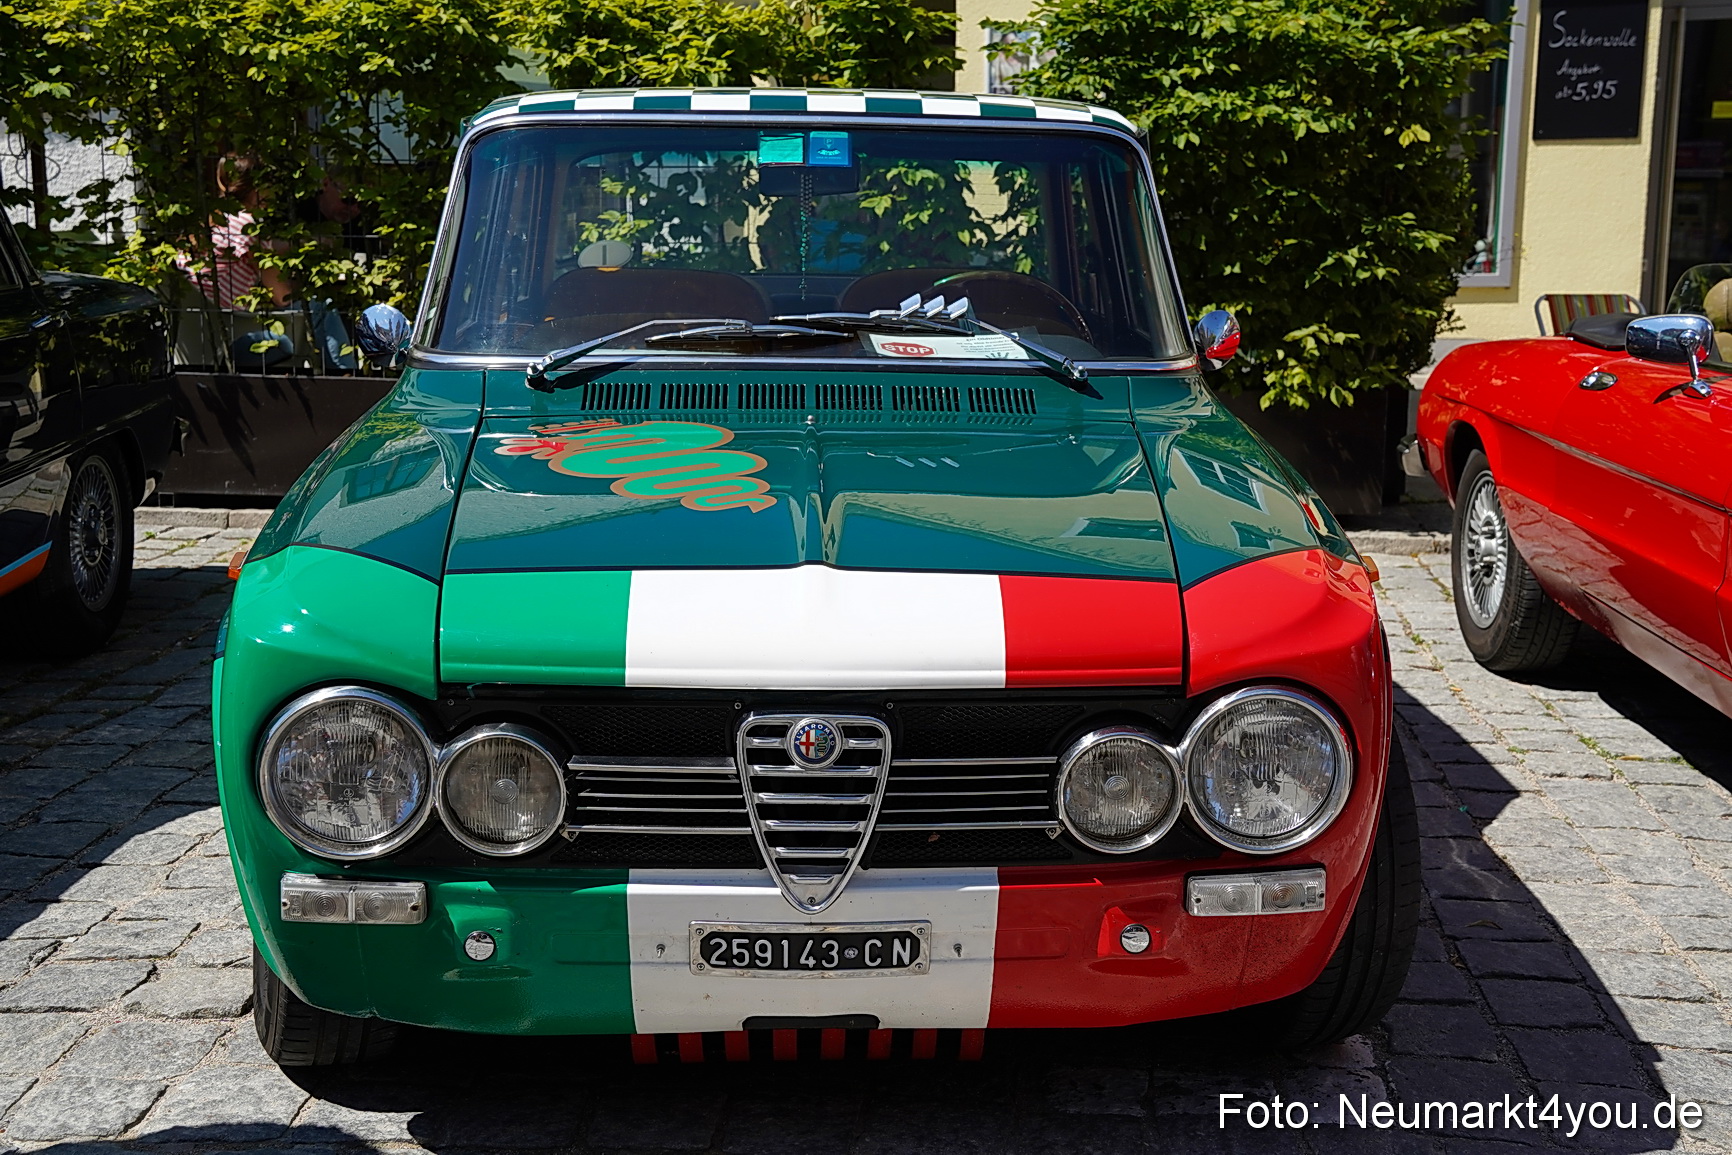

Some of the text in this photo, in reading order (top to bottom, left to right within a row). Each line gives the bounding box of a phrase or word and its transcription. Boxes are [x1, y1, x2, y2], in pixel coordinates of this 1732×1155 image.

[1549, 10, 1637, 48] Sockenwolle
[1555, 80, 1618, 101] ab 5,95
[884, 344, 930, 354] STOP
[795, 724, 835, 746] ALFA ROMEO
[709, 937, 839, 968] 259143
